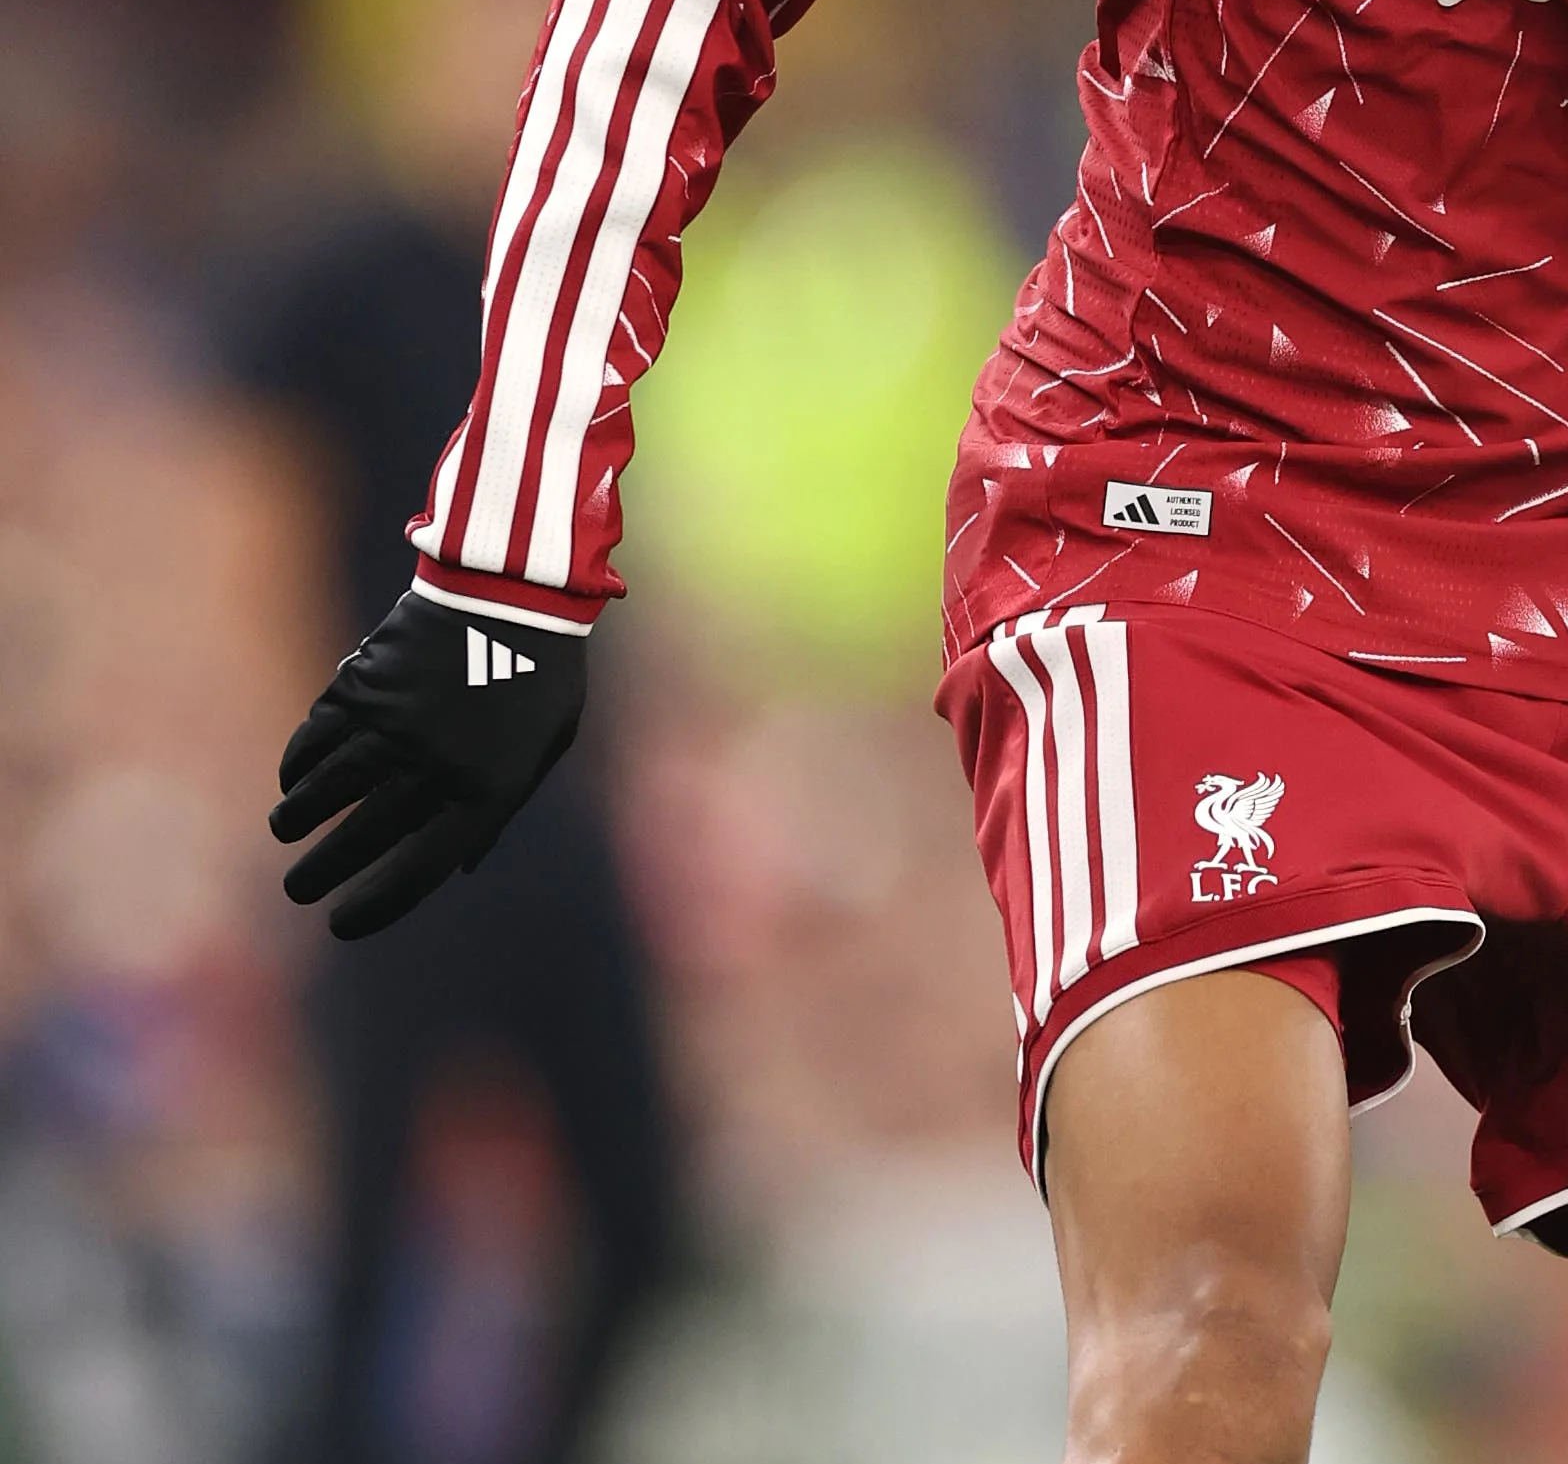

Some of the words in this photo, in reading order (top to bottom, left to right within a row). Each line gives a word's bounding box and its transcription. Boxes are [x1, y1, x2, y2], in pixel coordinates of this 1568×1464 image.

[1166, 496, 1202, 506] AUTHENTIC
[1170, 508, 1201, 517] LICENSED
[1170, 519, 1200, 529] PRODUCT
